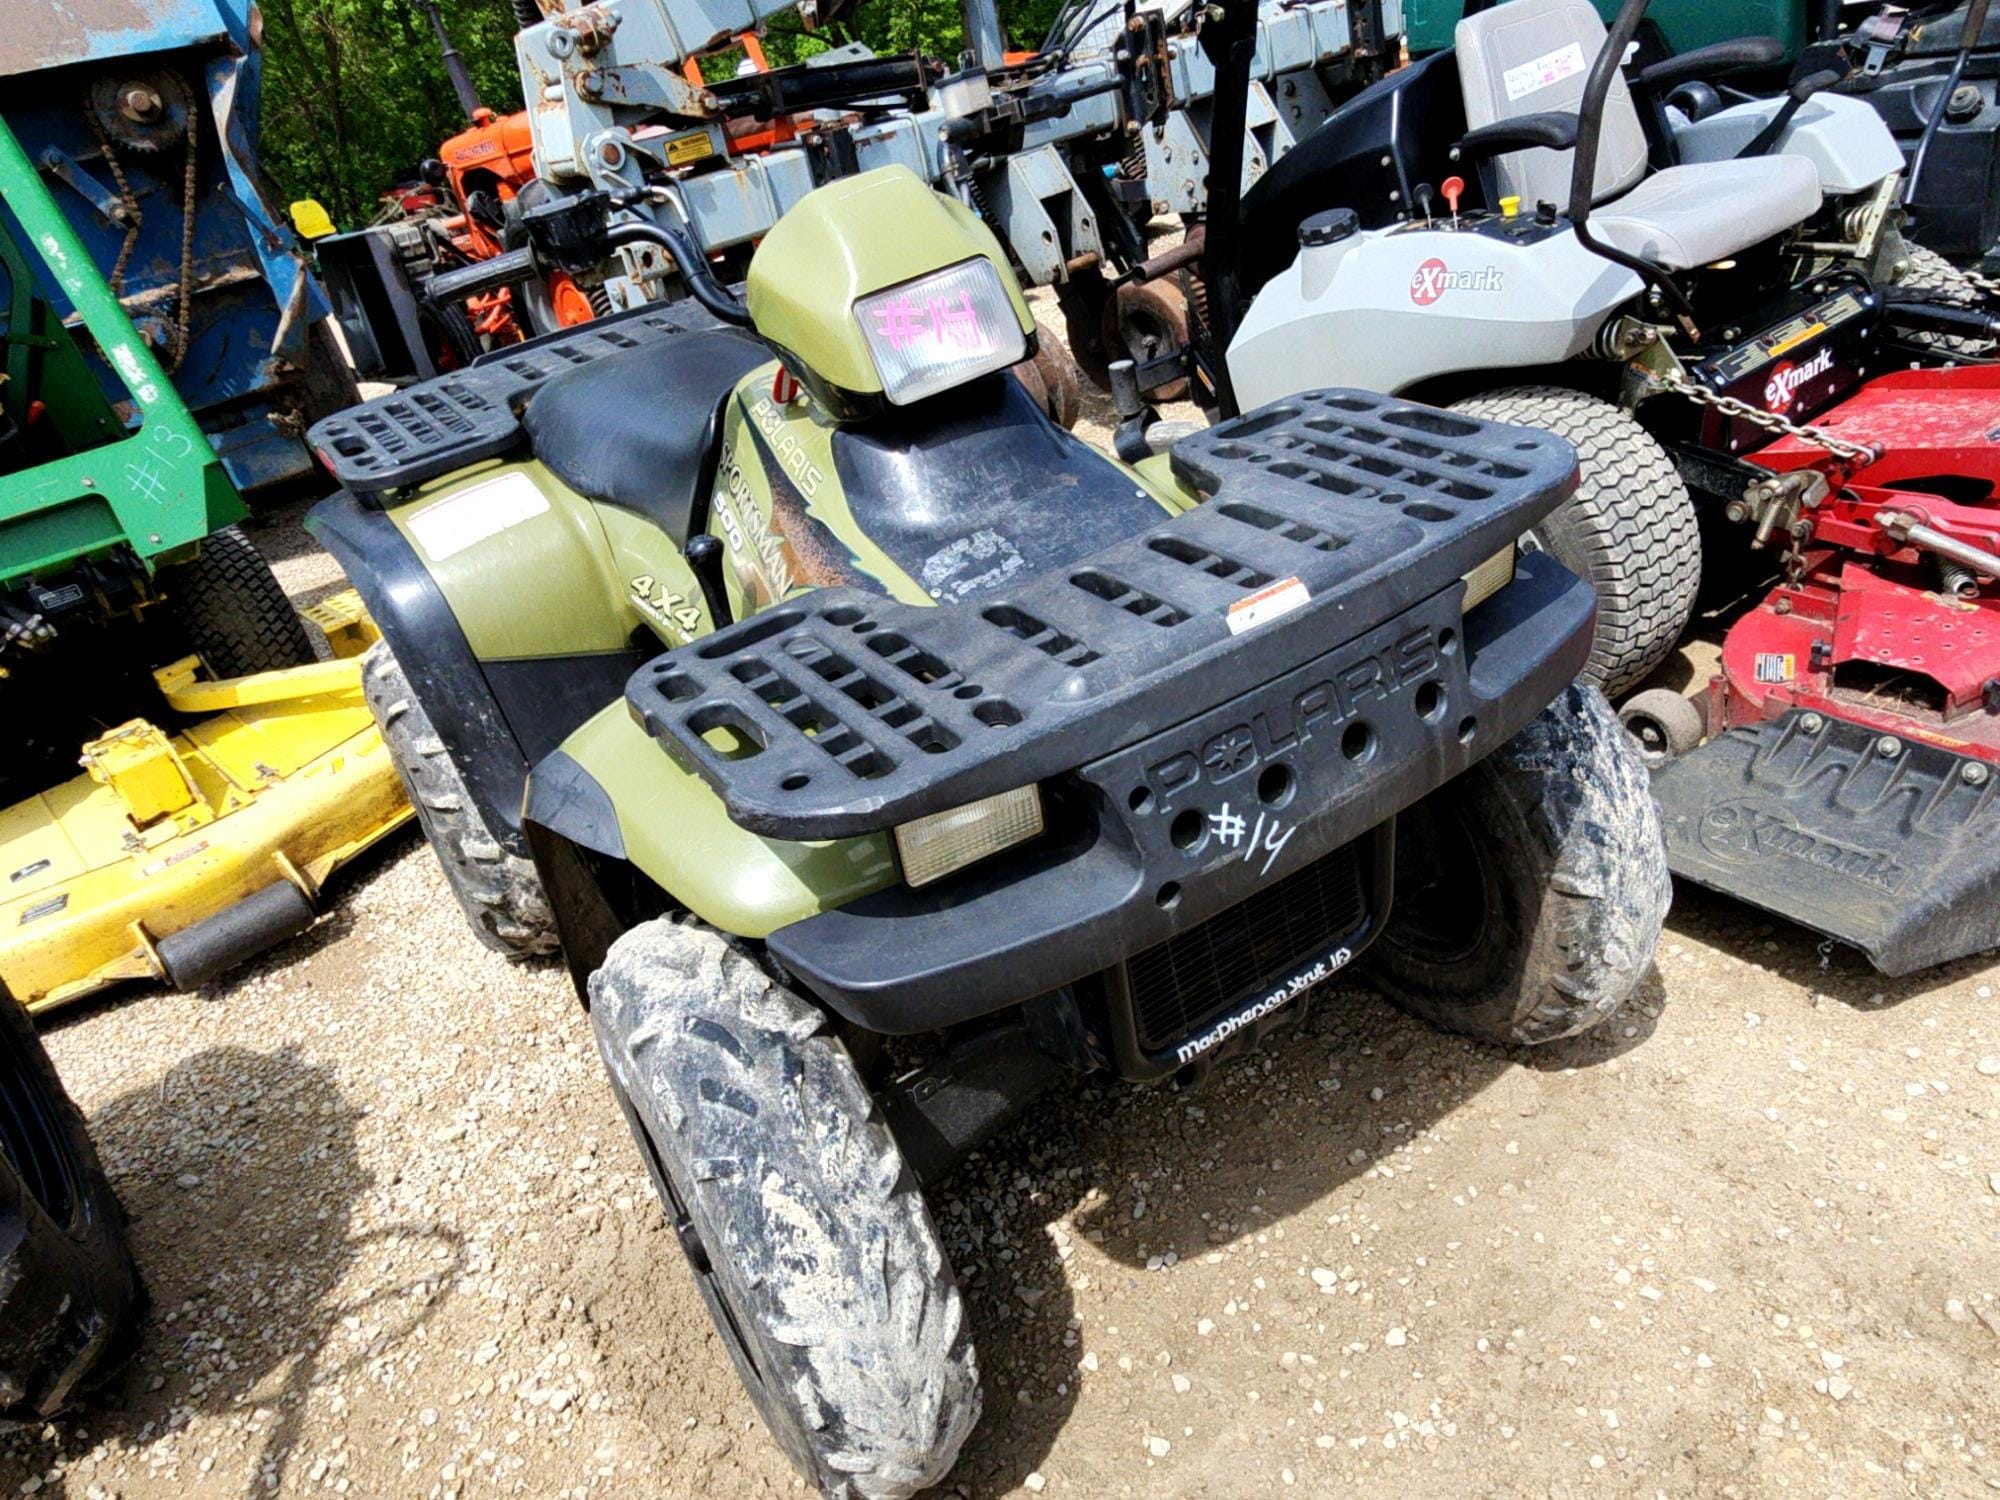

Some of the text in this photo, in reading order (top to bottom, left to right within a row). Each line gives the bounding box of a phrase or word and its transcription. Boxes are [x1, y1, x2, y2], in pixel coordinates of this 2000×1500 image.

[873, 289, 980, 351] #14
[126, 425, 192, 504] #13
[751, 397, 824, 498] POLARIS
[714, 491, 744, 551] 500
[719, 442, 794, 601] SPORTSMAN
[1147, 625, 1438, 814] POLARIS
[1208, 802, 1296, 876] #14
[1177, 989, 1288, 1063] MacPherson
[1287, 963, 1325, 994] Strut
